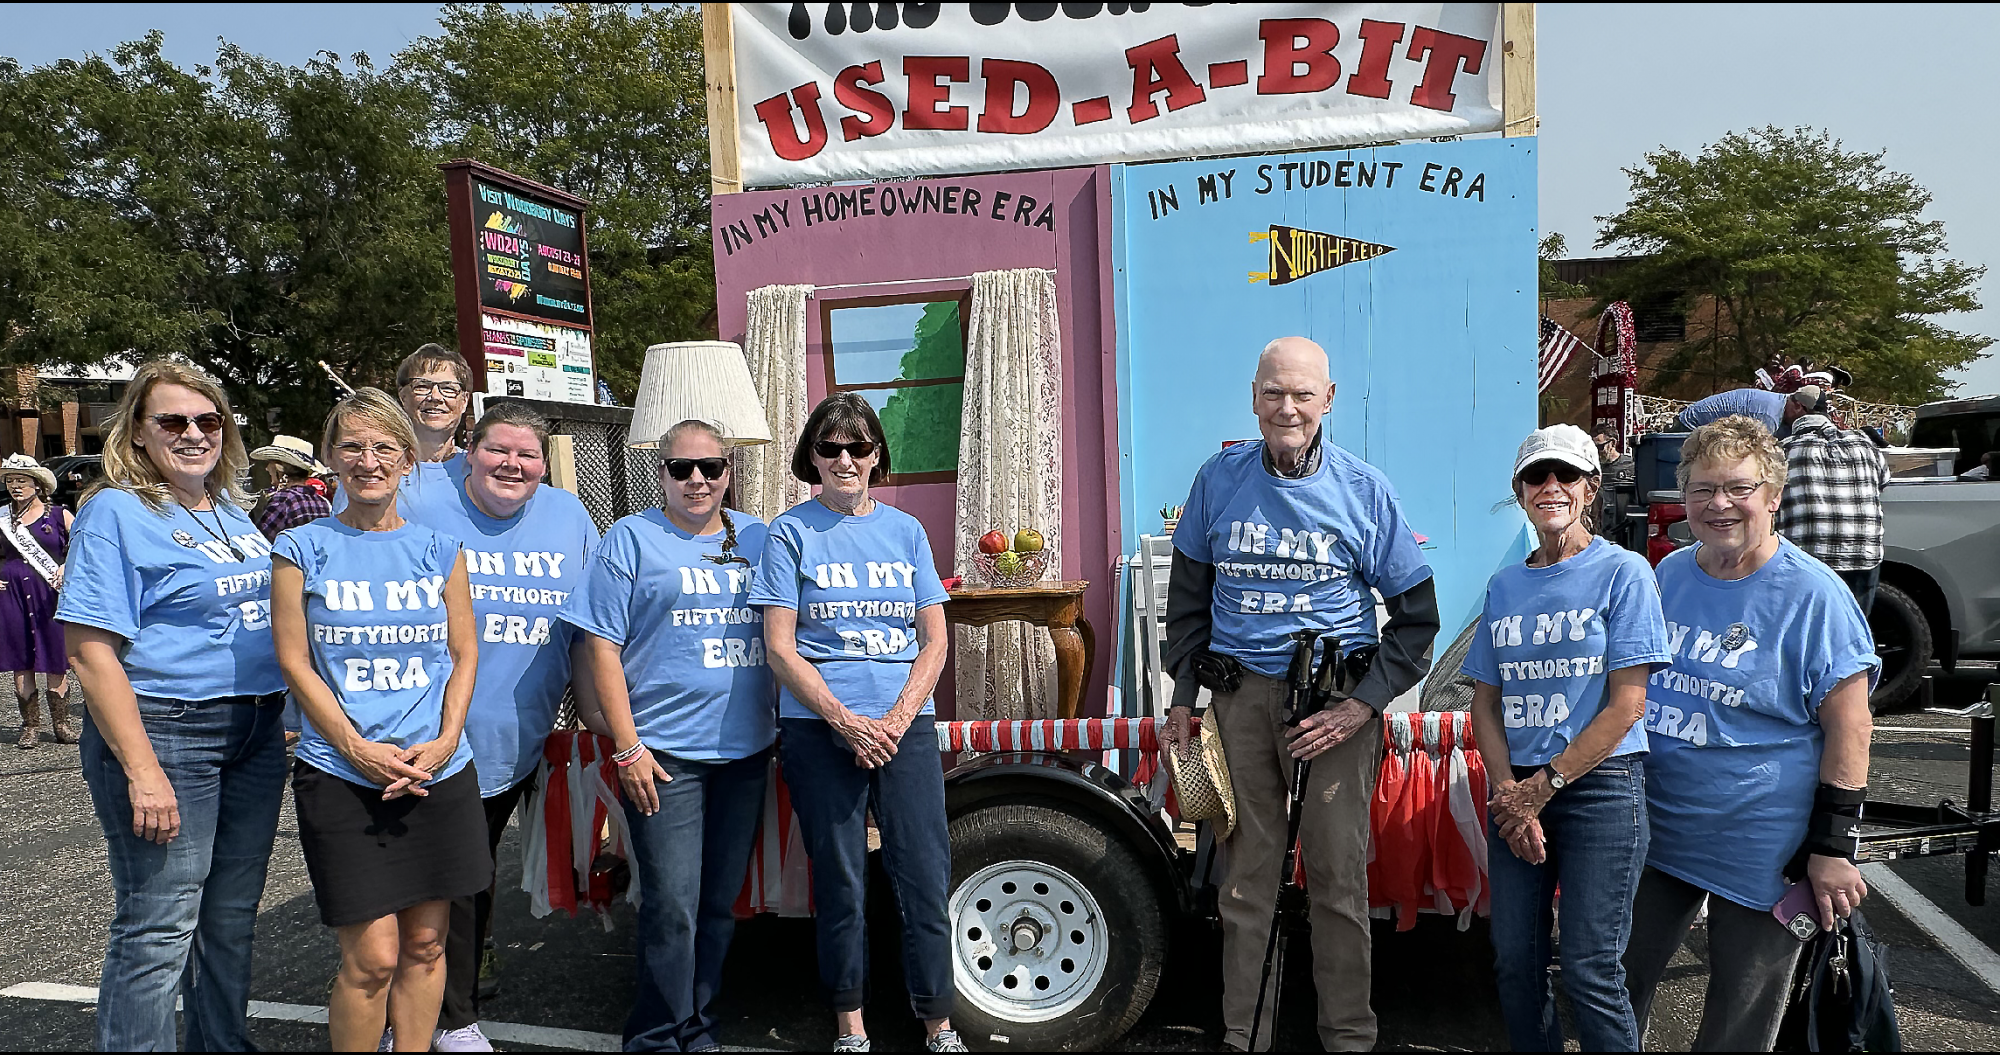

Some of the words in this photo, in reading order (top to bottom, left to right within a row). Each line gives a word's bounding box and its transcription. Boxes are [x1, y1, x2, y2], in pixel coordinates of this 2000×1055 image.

[753, 17, 1489, 162] USED-A-BIT
[1147, 184, 1179, 220] IN
[1197, 169, 1236, 205] MY
[1254, 161, 1404, 195] STUDENT
[1419, 163, 1486, 203] ERA
[719, 219, 754, 256] IN
[753, 199, 790, 239] MY
[802, 186, 982, 227] HOMEOWNER
[991, 191, 1055, 232] ERA
[485, 231, 519, 256] WD24
[1270, 229, 1385, 280] NORTHFIELD
[230, 531, 271, 559] M
[1227, 520, 1269, 556] IN
[1275, 527, 1339, 564] MY
[464, 548, 506, 577] IN
[512, 550, 566, 579] MY
[678, 565, 721, 595] IN
[724, 566, 754, 595] M
[816, 562, 859, 590] IN
[865, 561, 916, 590] MY
[323, 579, 375, 612] IN
[384, 574, 445, 612] MY
[469, 582, 572, 607] IFTYNORT
[1240, 590, 1314, 614] ERA
[483, 612, 551, 646] ERA
[837, 627, 909, 657] ERA
[1532, 607, 1596, 645] MY
[1666, 621, 1691, 655] N
[702, 637, 765, 668] ERA
[1498, 655, 1605, 682] TYNORTH
[343, 656, 431, 692] ERA
[1502, 693, 1571, 729] ERA
[1644, 699, 1708, 747] ERA
